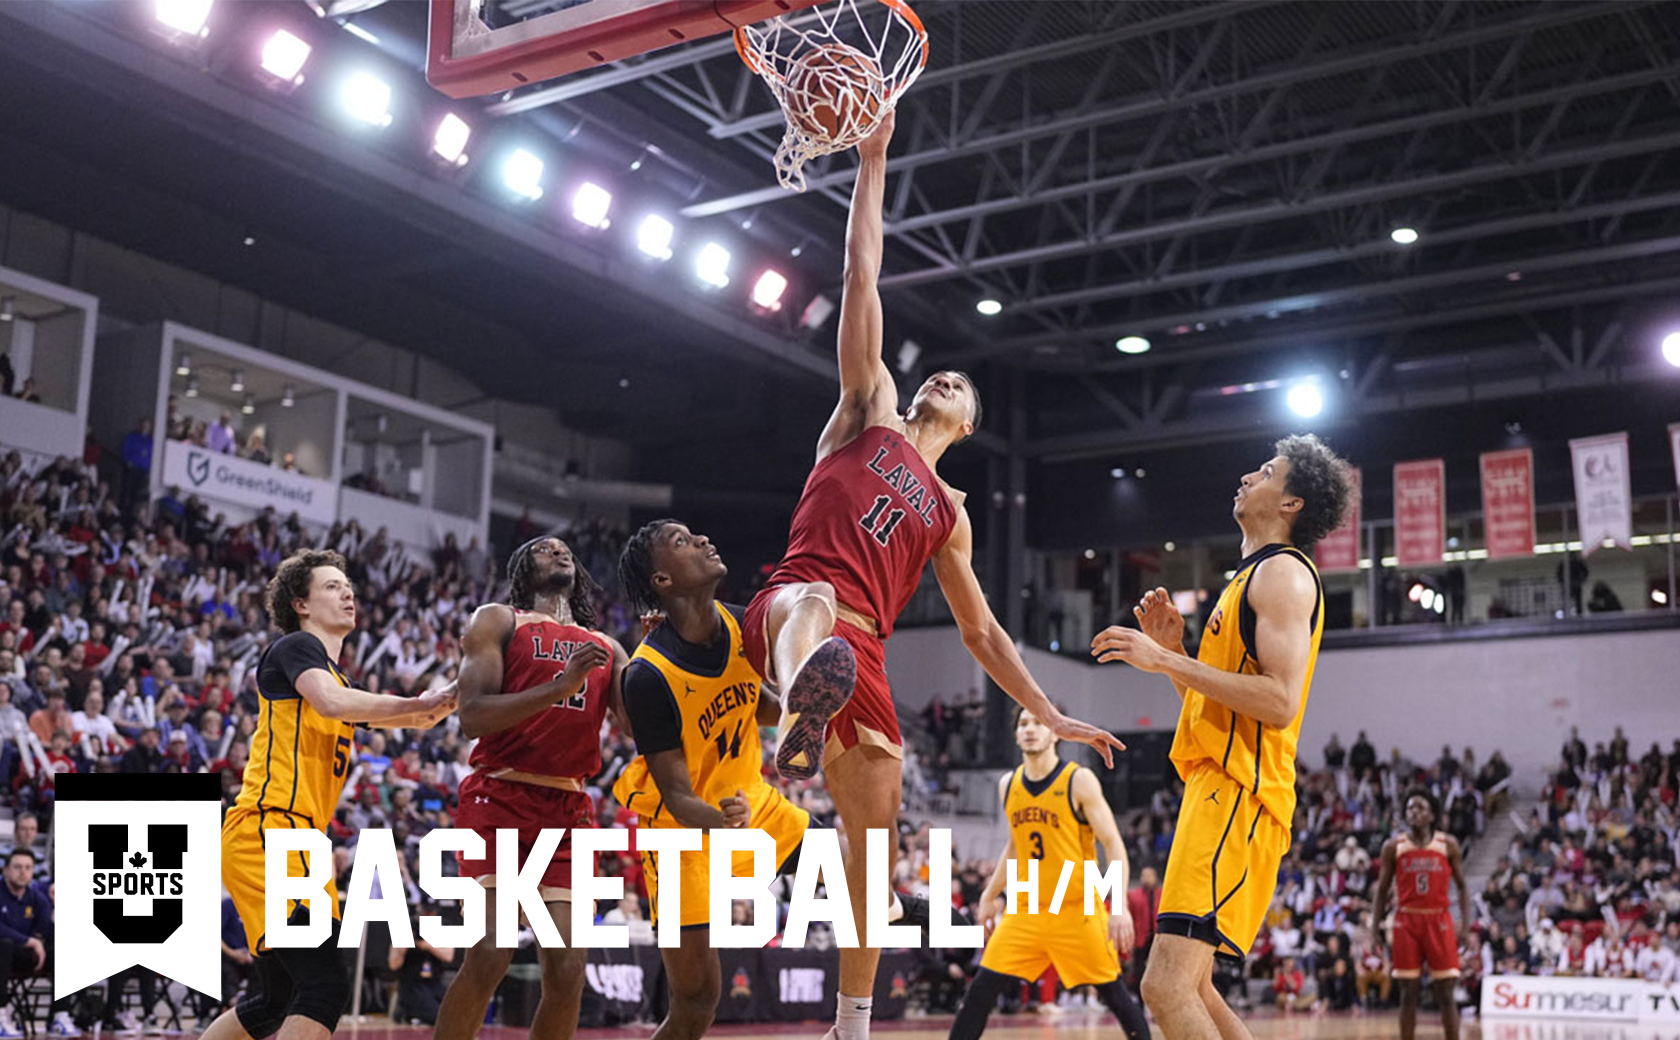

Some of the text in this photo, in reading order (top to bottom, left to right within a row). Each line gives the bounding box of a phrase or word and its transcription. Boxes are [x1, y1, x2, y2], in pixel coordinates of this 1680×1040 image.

[215, 465, 313, 504] GreenShield
[866, 446, 938, 527] LAVAL
[858, 494, 907, 547] 11
[698, 682, 757, 740] QUEEN'S
[333, 735, 351, 778] 5
[1012, 806, 1060, 829] QUEEN'S
[1029, 830, 1045, 861] 3
[1493, 982, 1631, 1012] Surmesur
